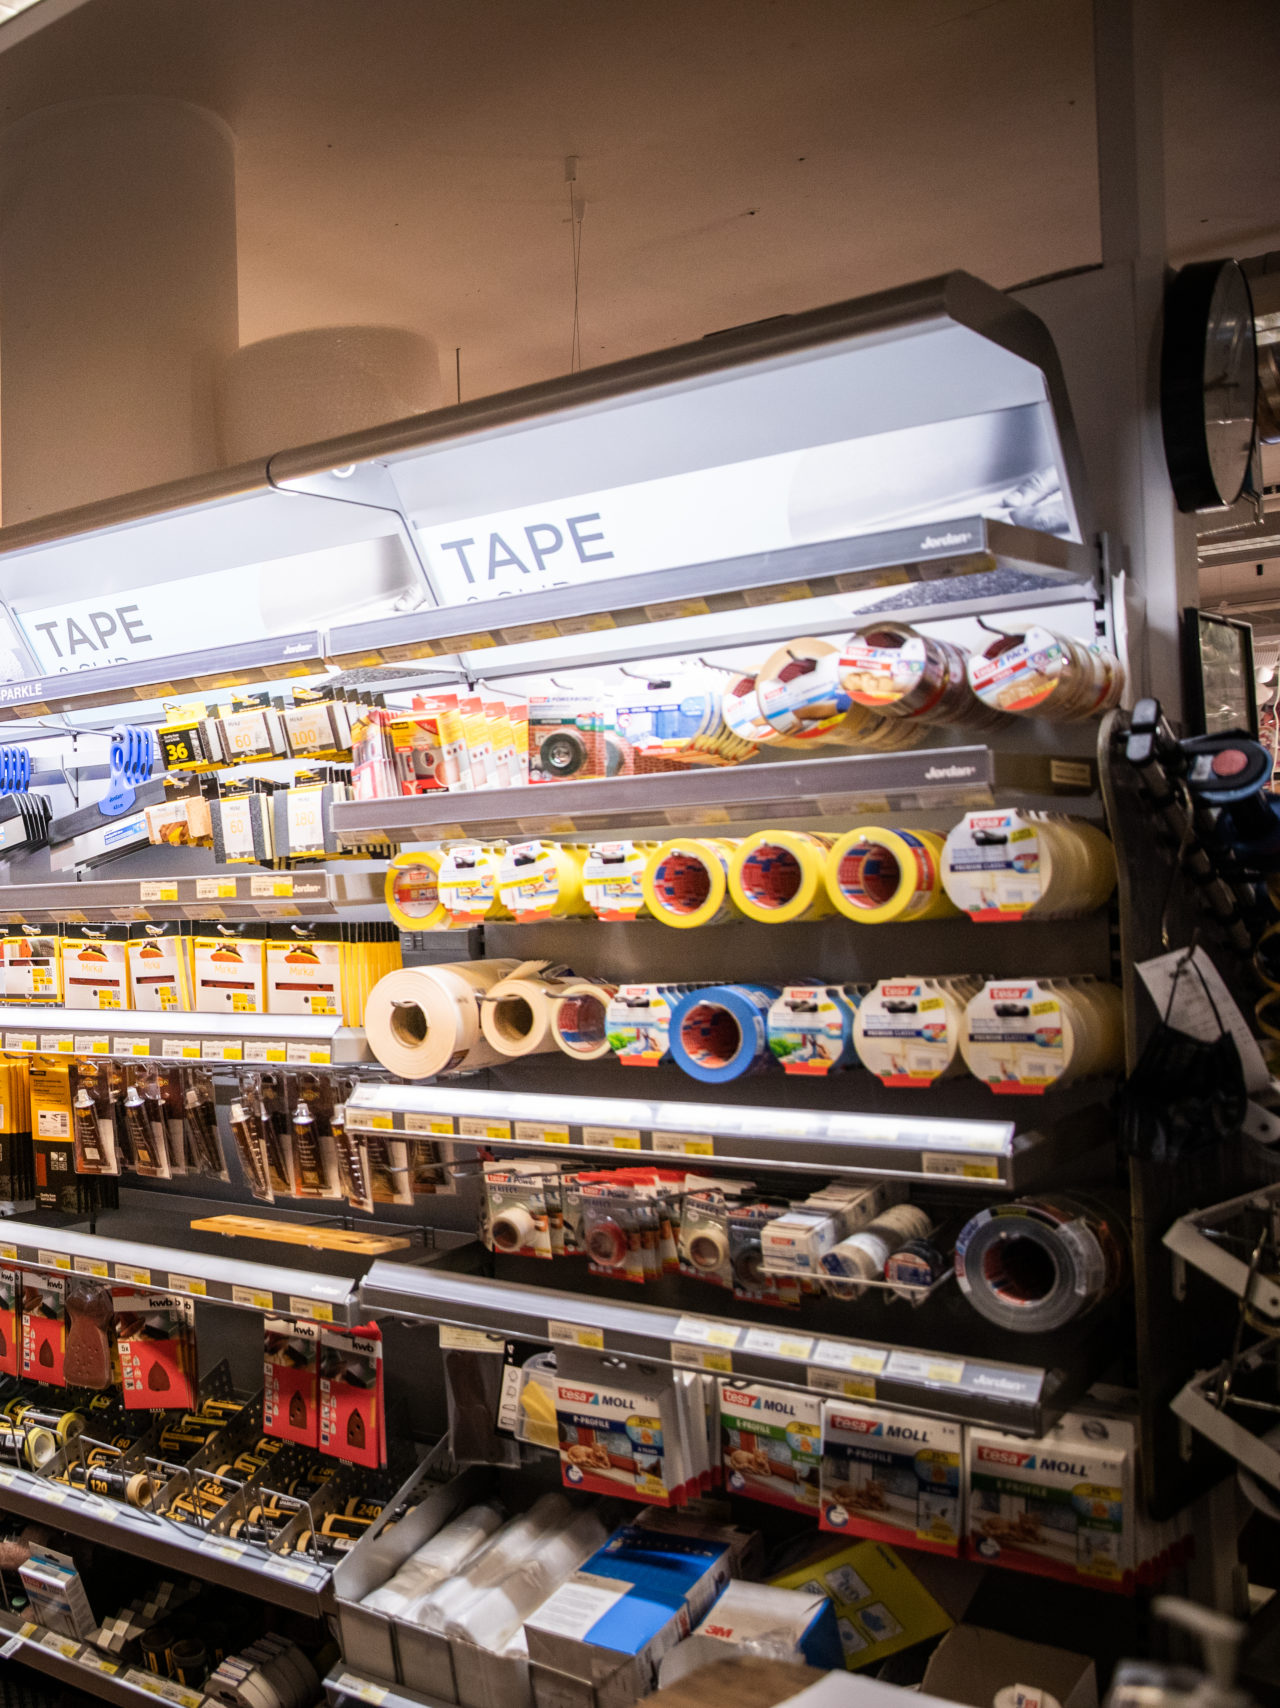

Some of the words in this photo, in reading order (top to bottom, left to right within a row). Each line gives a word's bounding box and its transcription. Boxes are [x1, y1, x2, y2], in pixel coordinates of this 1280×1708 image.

[440, 512, 615, 584] TAPE
[35, 604, 153, 658] TAPE
[235, 734, 252, 748] 60
[293, 729, 317, 745] 100
[166, 742, 189, 760] 36
[230, 820, 244, 834] 60
[295, 811, 316, 828] 180
[81, 964, 103, 975] Mirka
[214, 965, 238, 975] Mirka
[289, 966, 315, 976] Mirka
[1, 1272, 14, 1282] kwb
[46, 1277, 63, 1290] kwb
[148, 1297, 174, 1308] kwb
[292, 1322, 315, 1337] kwb
[351, 1337, 376, 1353] kwb
[561, 1389, 587, 1403] tesa
[602, 1395, 636, 1410] MOLL
[725, 1391, 751, 1405] tesa
[764, 1399, 796, 1416] MOLL
[572, 1414, 611, 1429] P-PROFILE
[736, 1418, 772, 1435] E-PROFILE
[833, 1416, 868, 1431] tesa
[886, 1425, 930, 1443] MOLL
[116, 1438, 131, 1448] 80
[982, 1449, 1019, 1466] tesa
[1040, 1458, 1089, 1477] MOLL
[90, 1479, 108, 1494] 120
[203, 1481, 224, 1496] 120
[358, 1503, 382, 1518] 240
[704, 1624, 734, 1639] 3M
